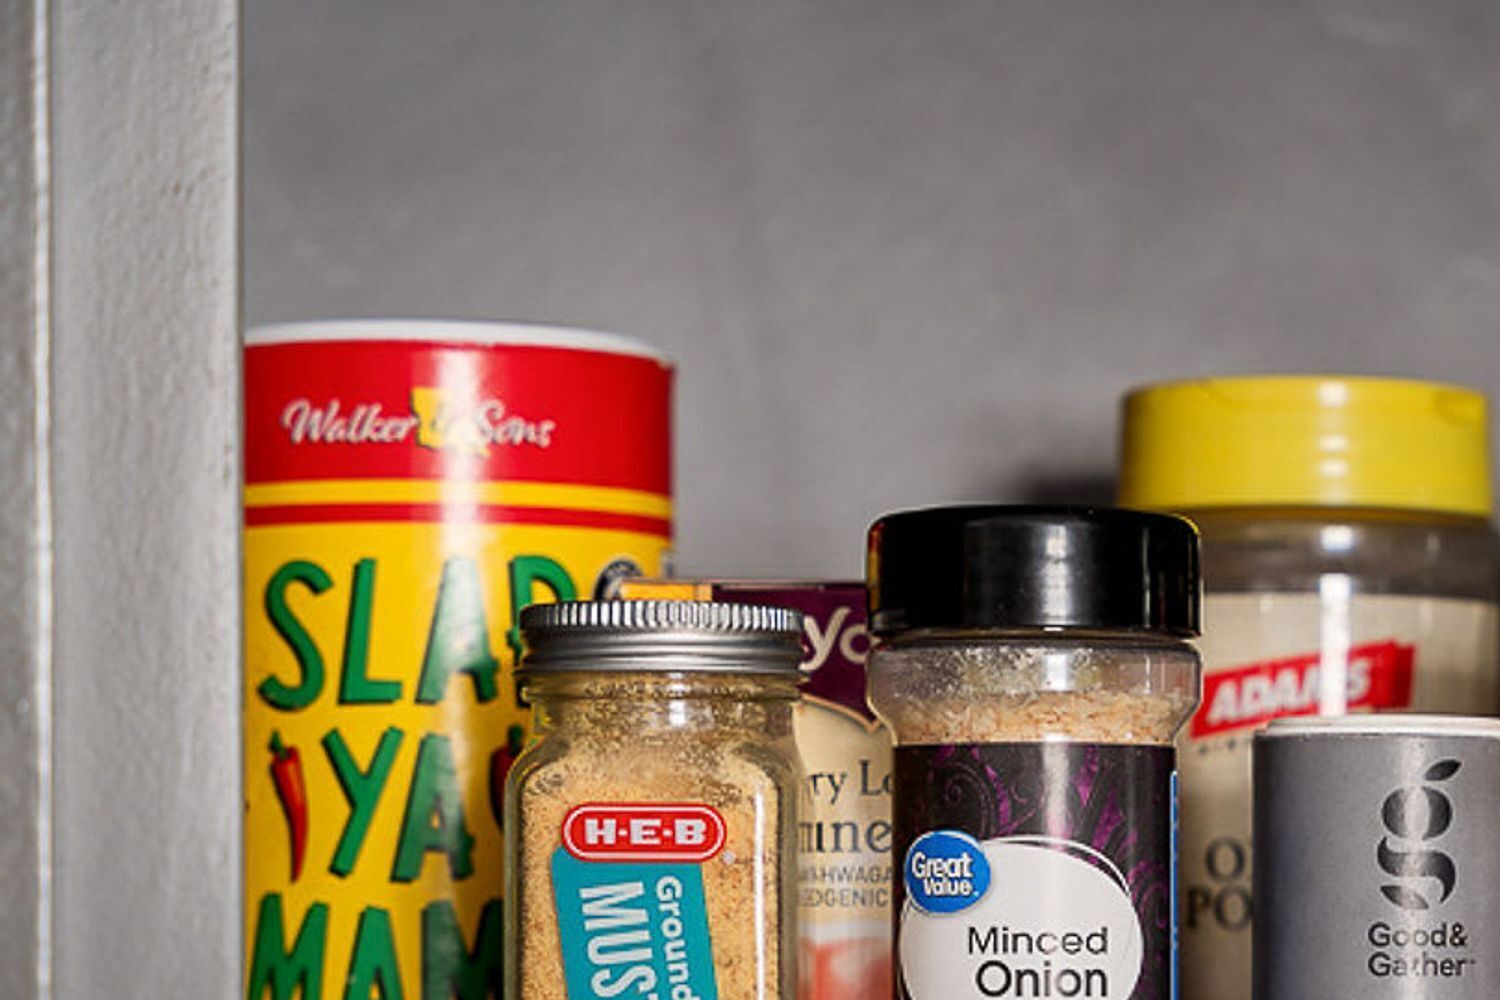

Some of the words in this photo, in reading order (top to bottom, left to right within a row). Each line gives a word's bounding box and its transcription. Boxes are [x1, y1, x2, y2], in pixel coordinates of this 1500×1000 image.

[281, 399, 419, 446] Walker
[474, 398, 557, 449] Sons
[320, 725, 476, 883] YA
[912, 851, 974, 879] Great
[923, 876, 973, 896] Value
[968, 926, 1108, 956] Minced
[975, 960, 1108, 998] Onion
